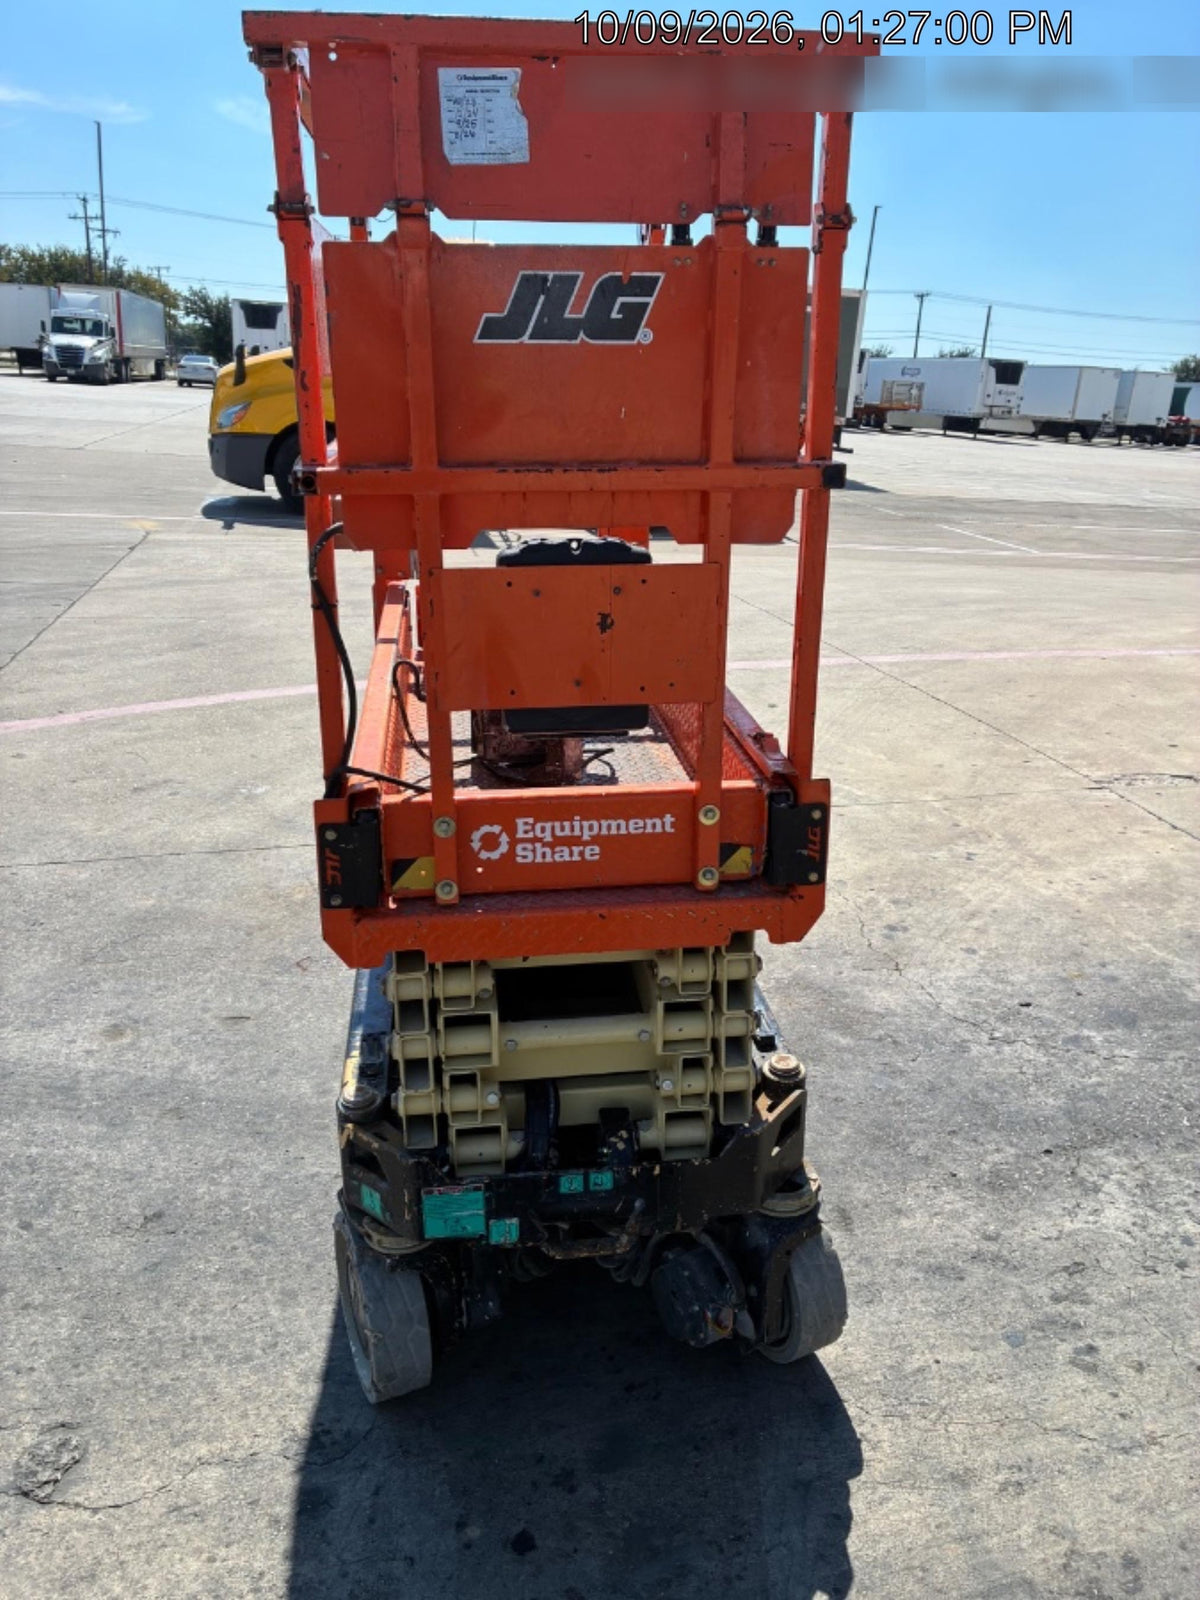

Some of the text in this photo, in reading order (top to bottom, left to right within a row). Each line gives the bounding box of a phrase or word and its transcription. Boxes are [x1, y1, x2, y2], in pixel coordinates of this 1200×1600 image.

[473, 270, 665, 344] JLG
[515, 814, 676, 841] Equipment
[515, 843, 601, 863] Share
